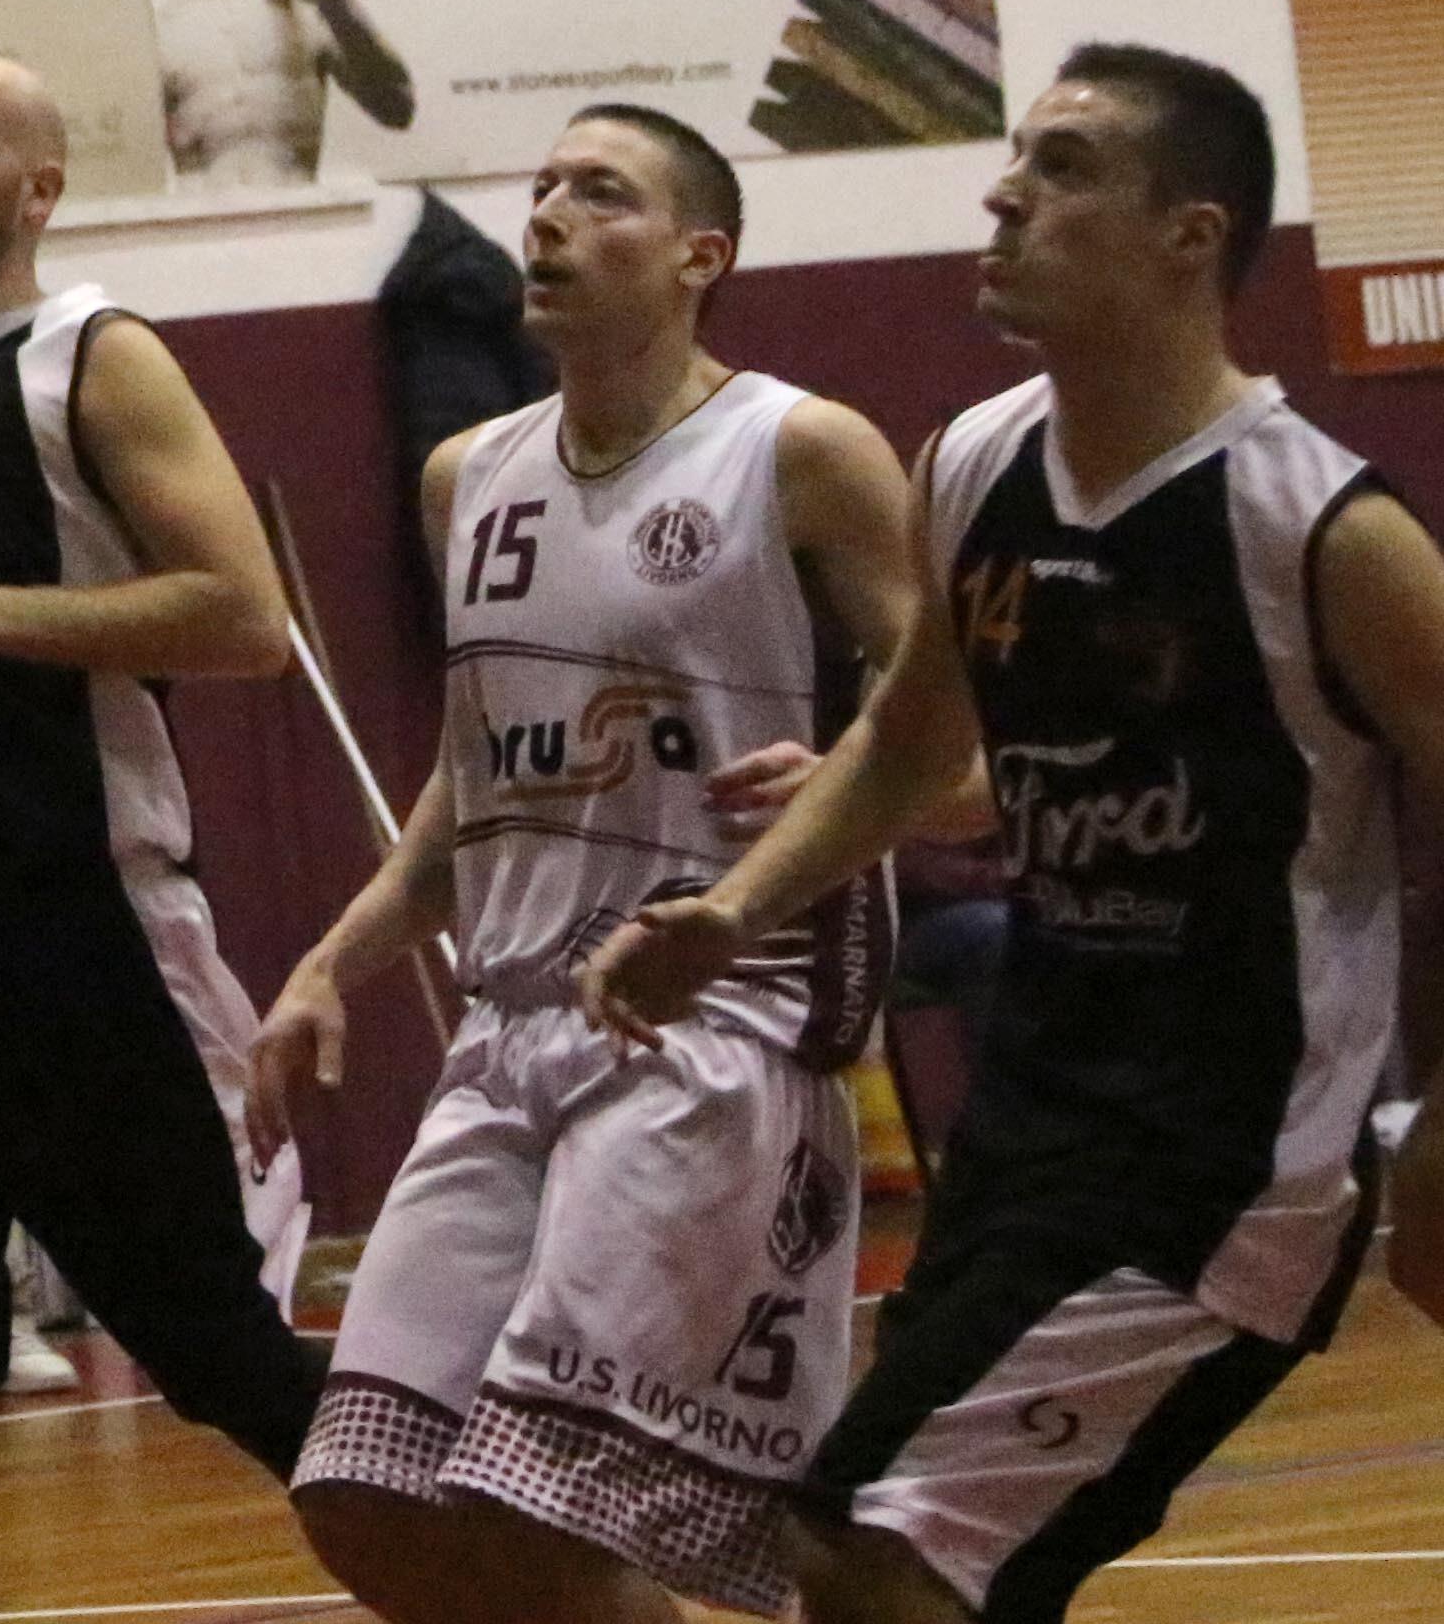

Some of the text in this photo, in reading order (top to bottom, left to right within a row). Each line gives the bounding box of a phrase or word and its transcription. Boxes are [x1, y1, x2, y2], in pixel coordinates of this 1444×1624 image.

[462, 498, 548, 607] 15
[548, 1346, 804, 1463] U.S. LIVORNO
